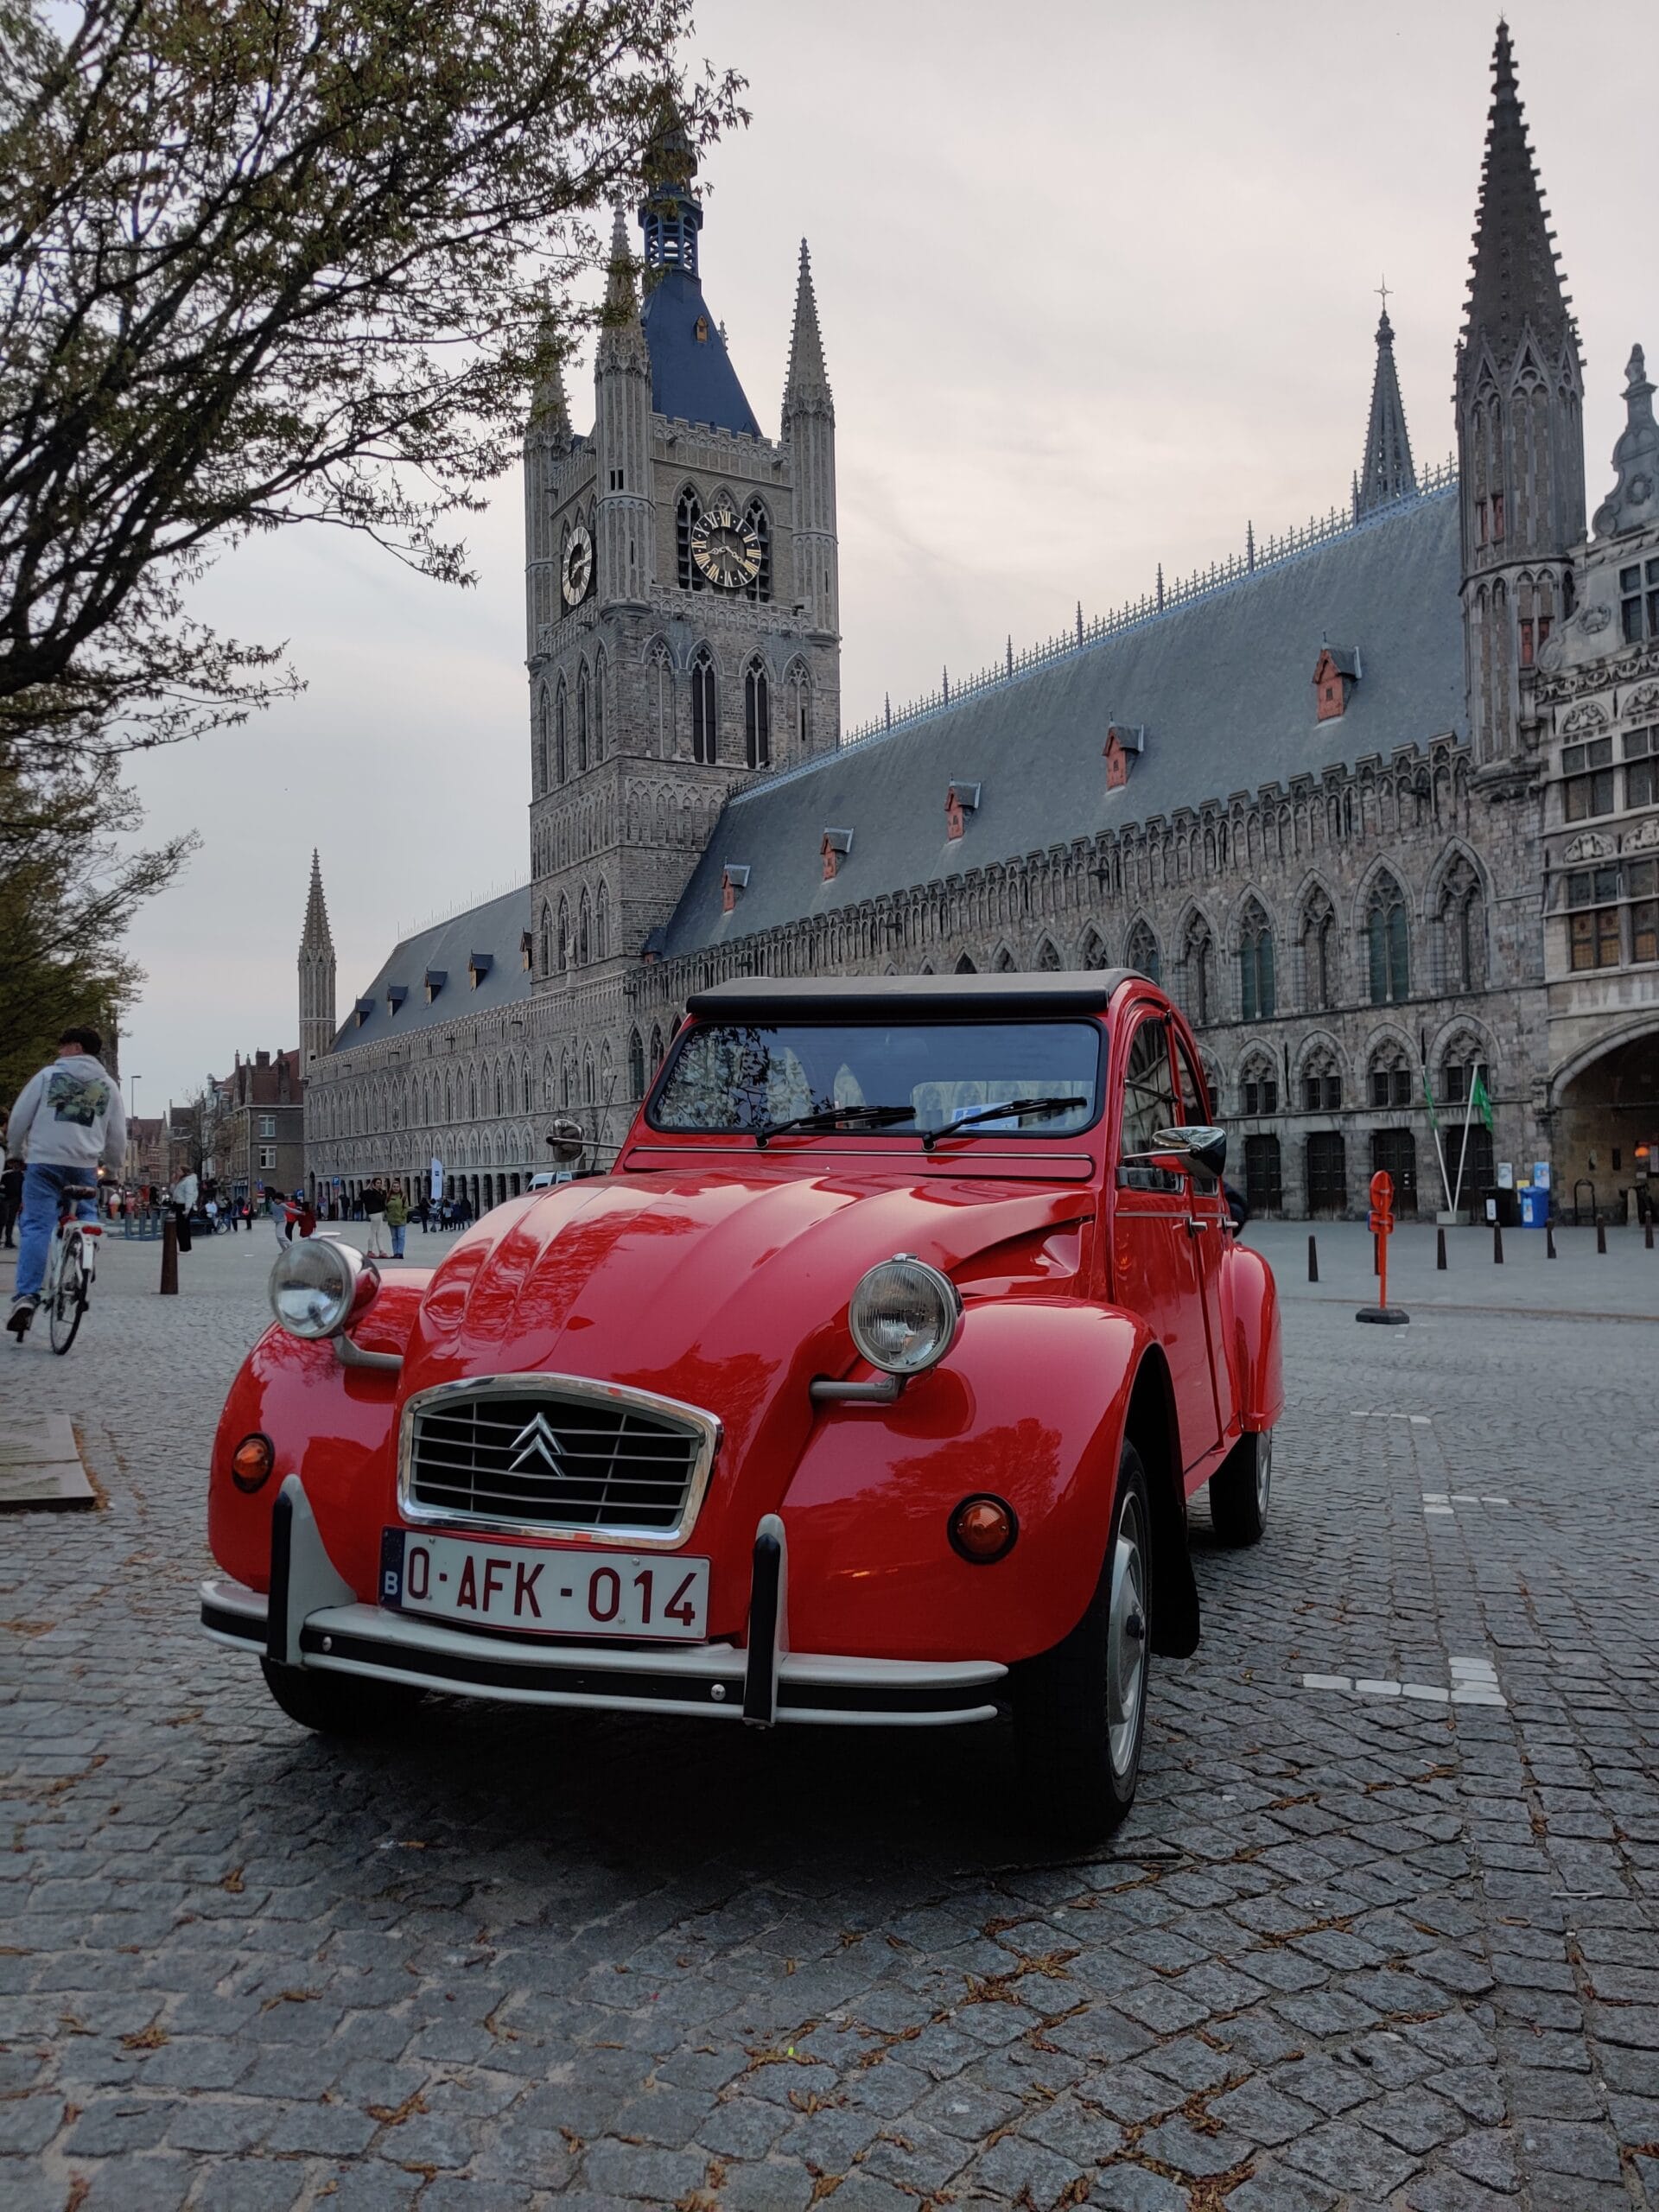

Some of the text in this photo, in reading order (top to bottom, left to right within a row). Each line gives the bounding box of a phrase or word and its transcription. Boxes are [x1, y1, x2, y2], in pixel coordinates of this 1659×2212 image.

[719, 511, 731, 528] XII
[734, 518, 744, 532] I
[694, 522, 710, 537] X
[743, 532, 758, 543] II
[746, 549, 761, 559] III
[724, 571, 734, 587] VI
[737, 569, 748, 584] V
[385, 1571, 398, 1596] B
